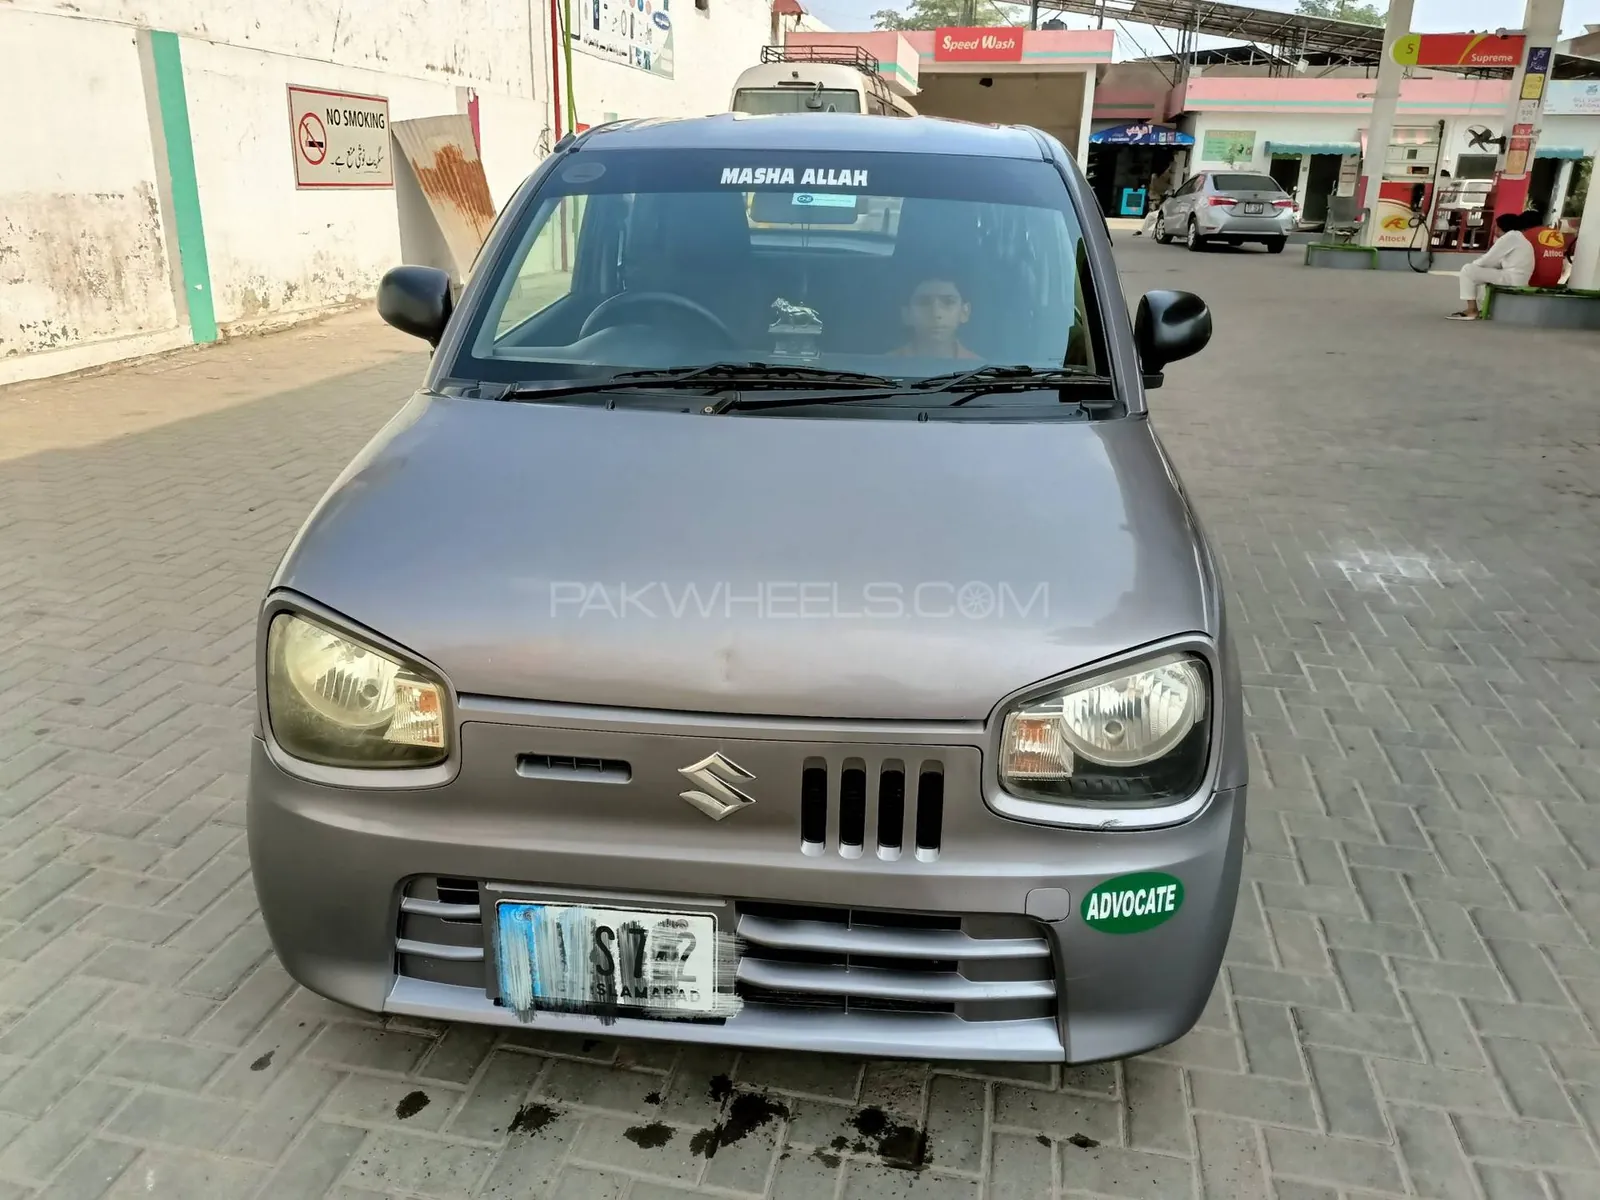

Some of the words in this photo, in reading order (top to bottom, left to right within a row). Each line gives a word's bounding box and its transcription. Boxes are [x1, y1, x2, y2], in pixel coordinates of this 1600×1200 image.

[942, 35, 980, 52] Speed
[981, 35, 1016, 50] Wash
[1471, 53, 1514, 63] Supreme
[326, 108, 341, 126] NO
[343, 109, 385, 129] SMOKING
[720, 167, 795, 184] MASHA
[800, 168, 868, 186] ALLAH
[1378, 235, 1407, 243] Attock
[1543, 250, 1564, 258] Attoc
[1086, 884, 1176, 920] ADVOCATE
